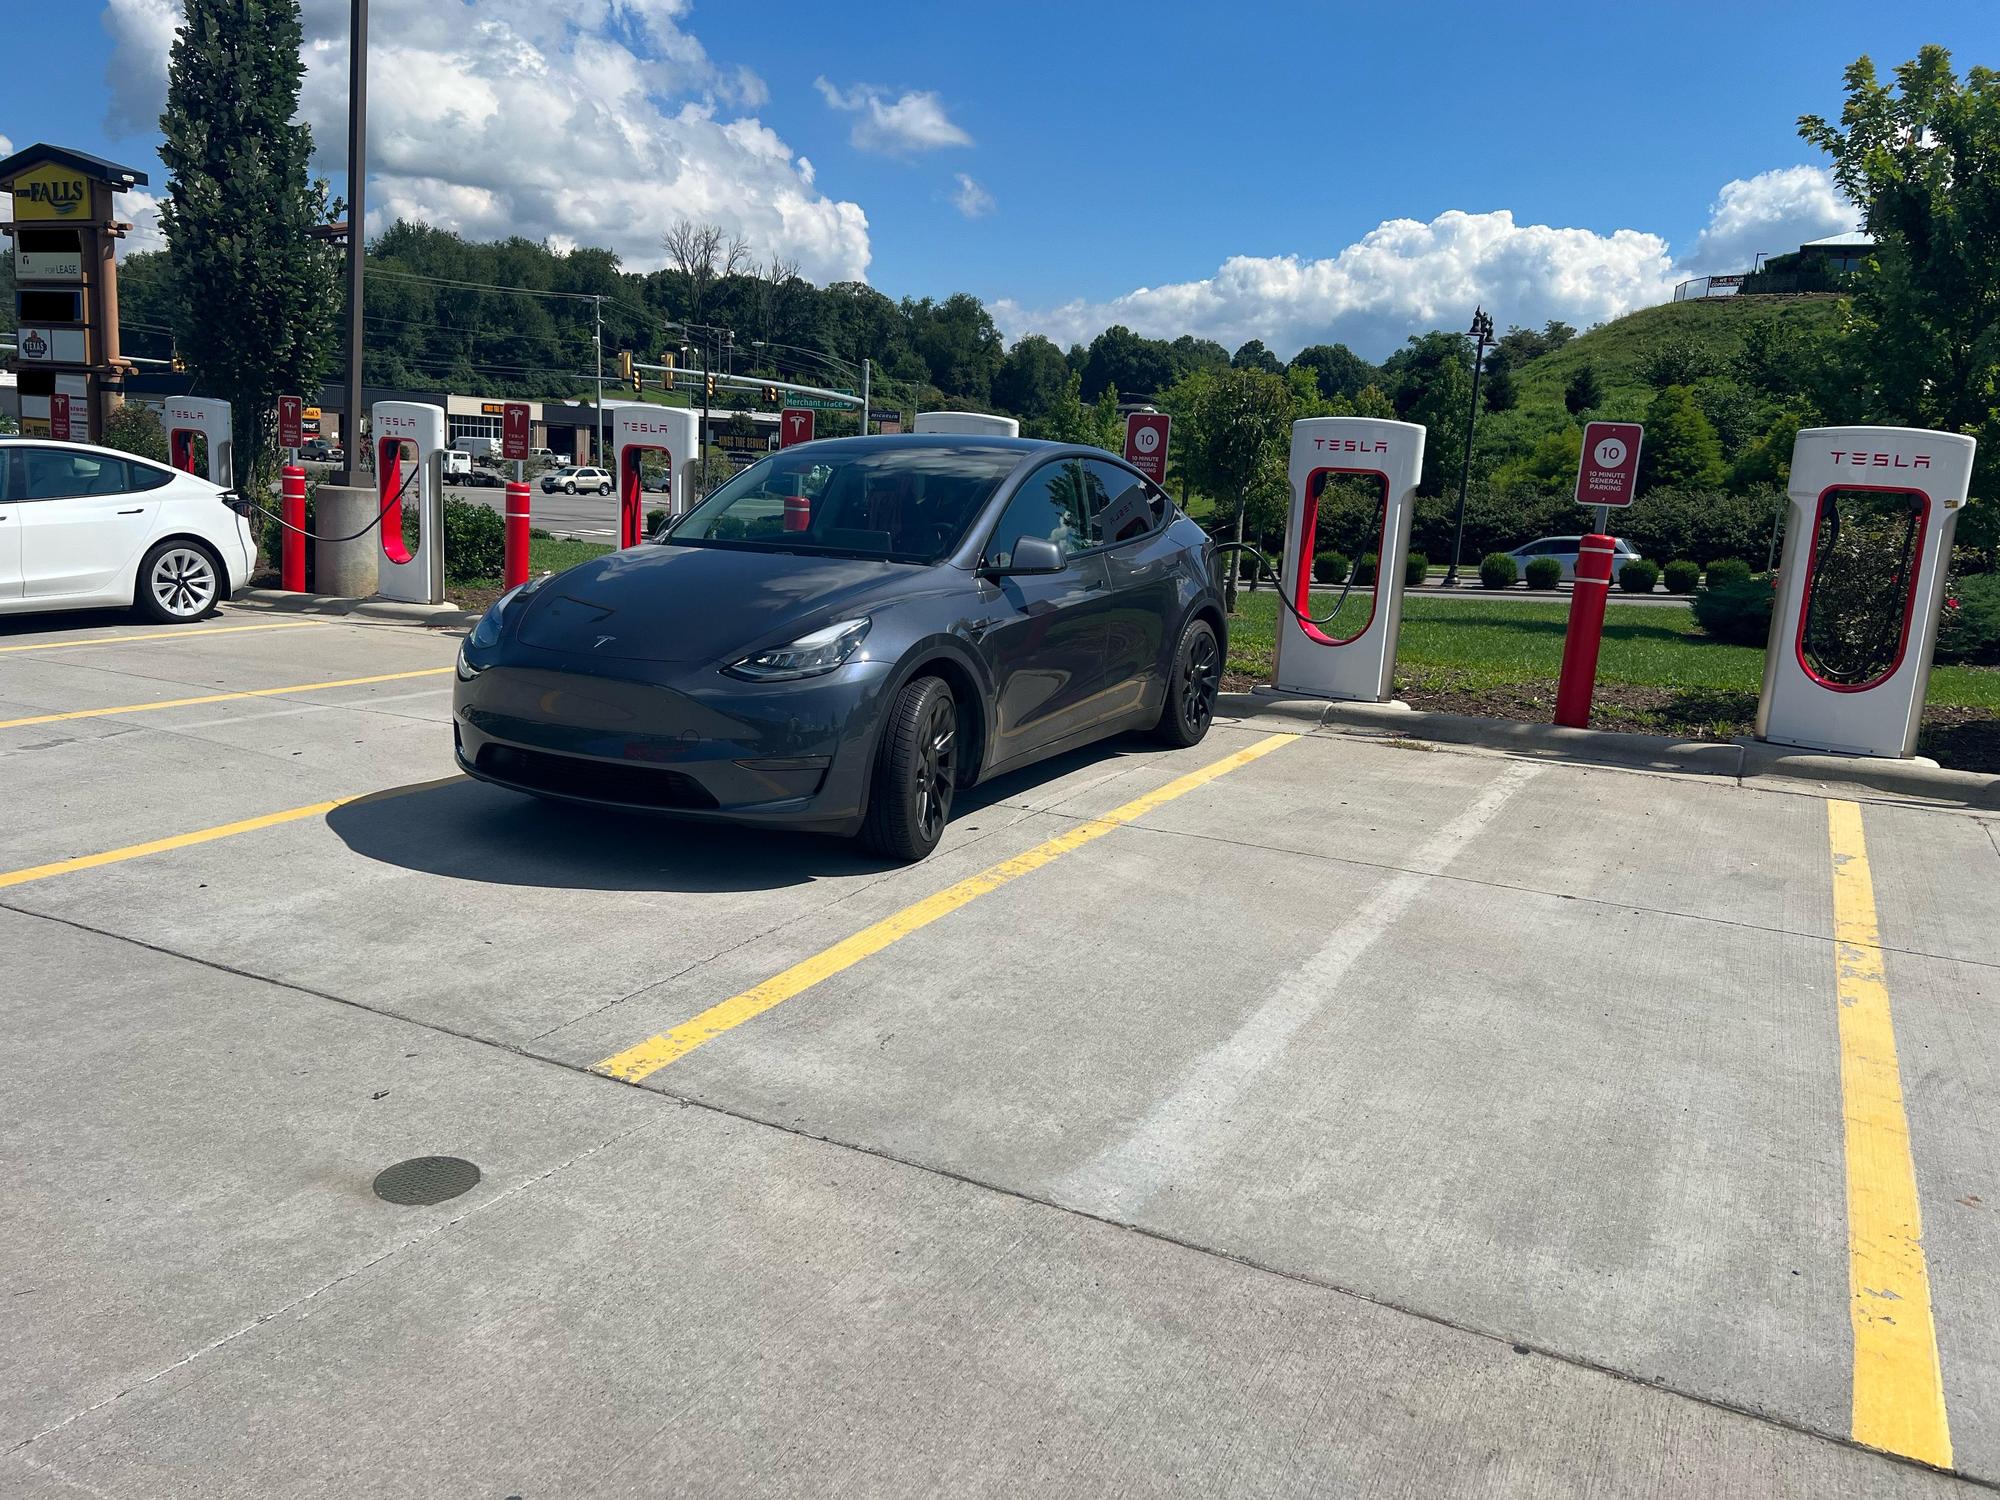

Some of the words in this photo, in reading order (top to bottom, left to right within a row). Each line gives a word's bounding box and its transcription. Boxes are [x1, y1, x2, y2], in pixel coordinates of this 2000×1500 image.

[30, 181, 83, 203] FALLS
[56, 264, 77, 274] LEASE
[786, 399, 821, 407] Merchant
[171, 410, 204, 419] TESLA
[378, 416, 416, 427] TESLA
[623, 422, 668, 433] TESLA
[1140, 434, 1154, 446] 10
[1314, 439, 1388, 453] TESLA
[1602, 446, 1620, 460] 10
[1830, 451, 1931, 469] TESLA
[1598, 471, 1626, 479] MINUTE
[1589, 477, 1623, 485] GENERAL
[1589, 484, 1622, 492] PARKING
